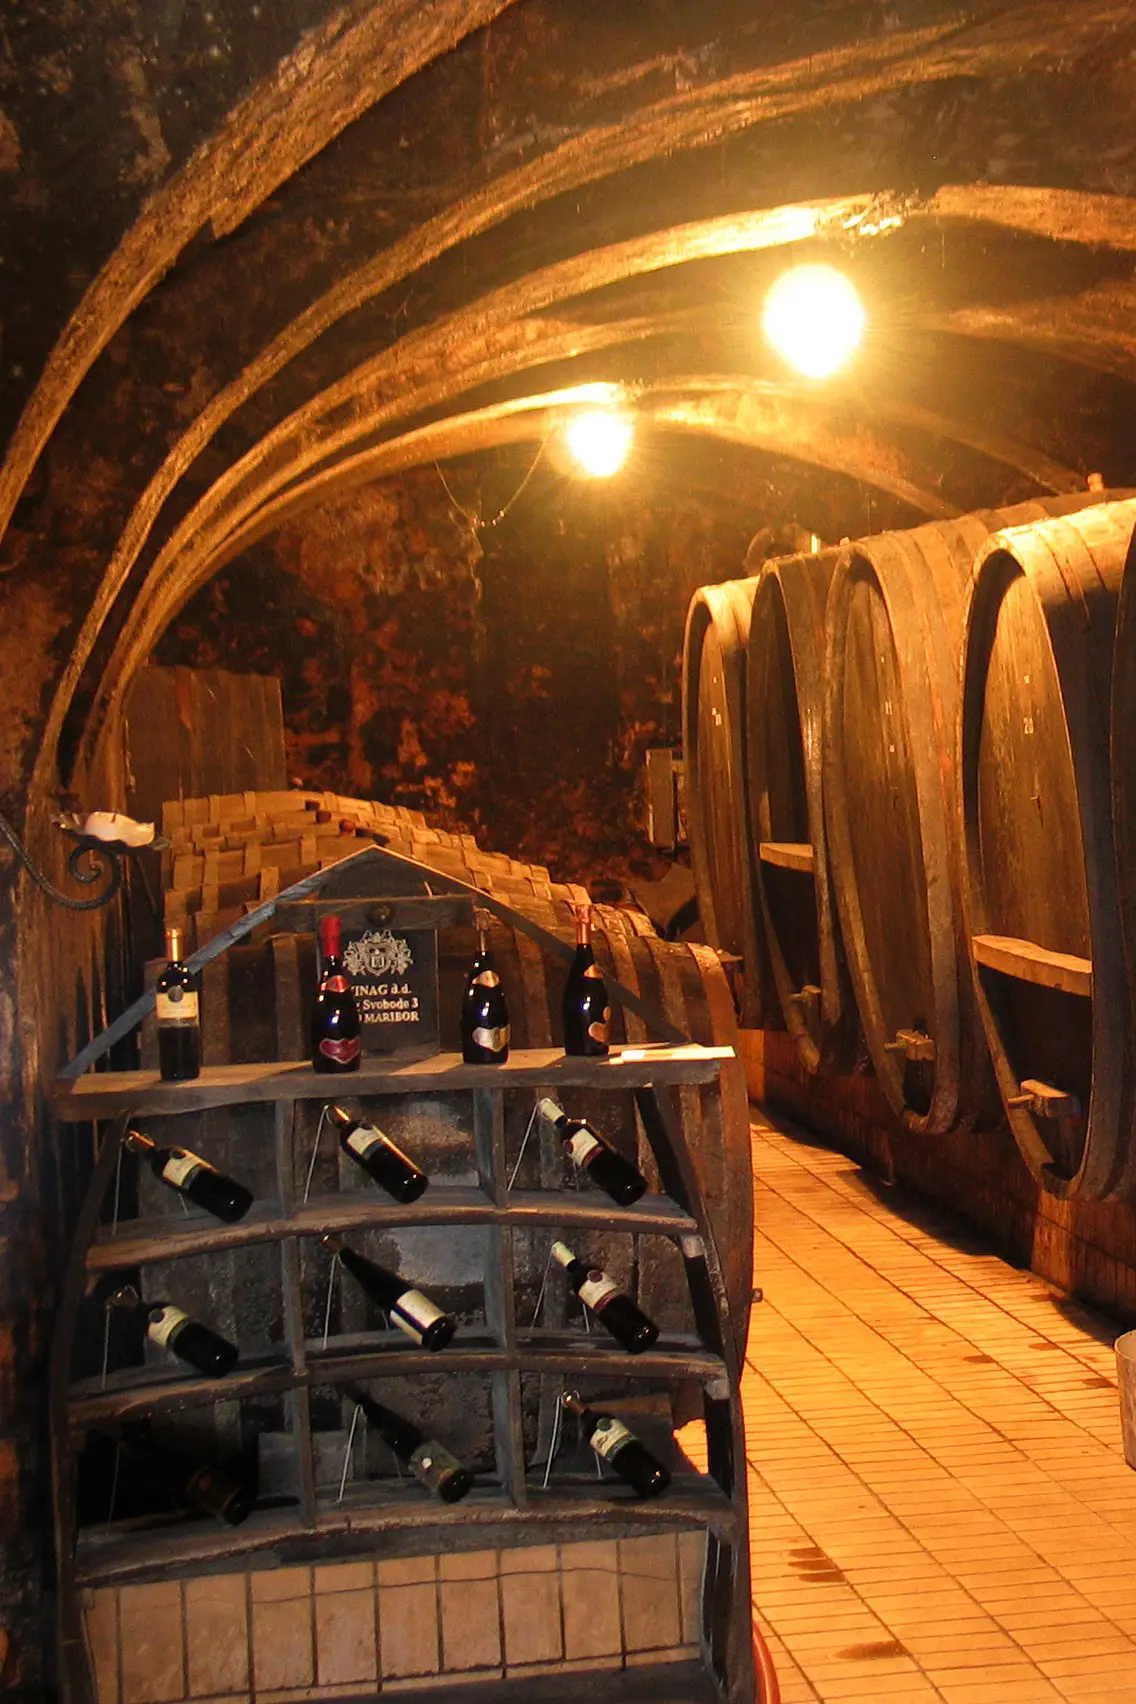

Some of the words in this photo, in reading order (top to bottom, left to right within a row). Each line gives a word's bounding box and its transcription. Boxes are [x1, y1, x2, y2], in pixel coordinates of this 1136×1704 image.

[362, 998, 410, 1010] Svobode
[411, 996, 419, 1009] 3
[363, 1010, 420, 1023] MARIBOR
